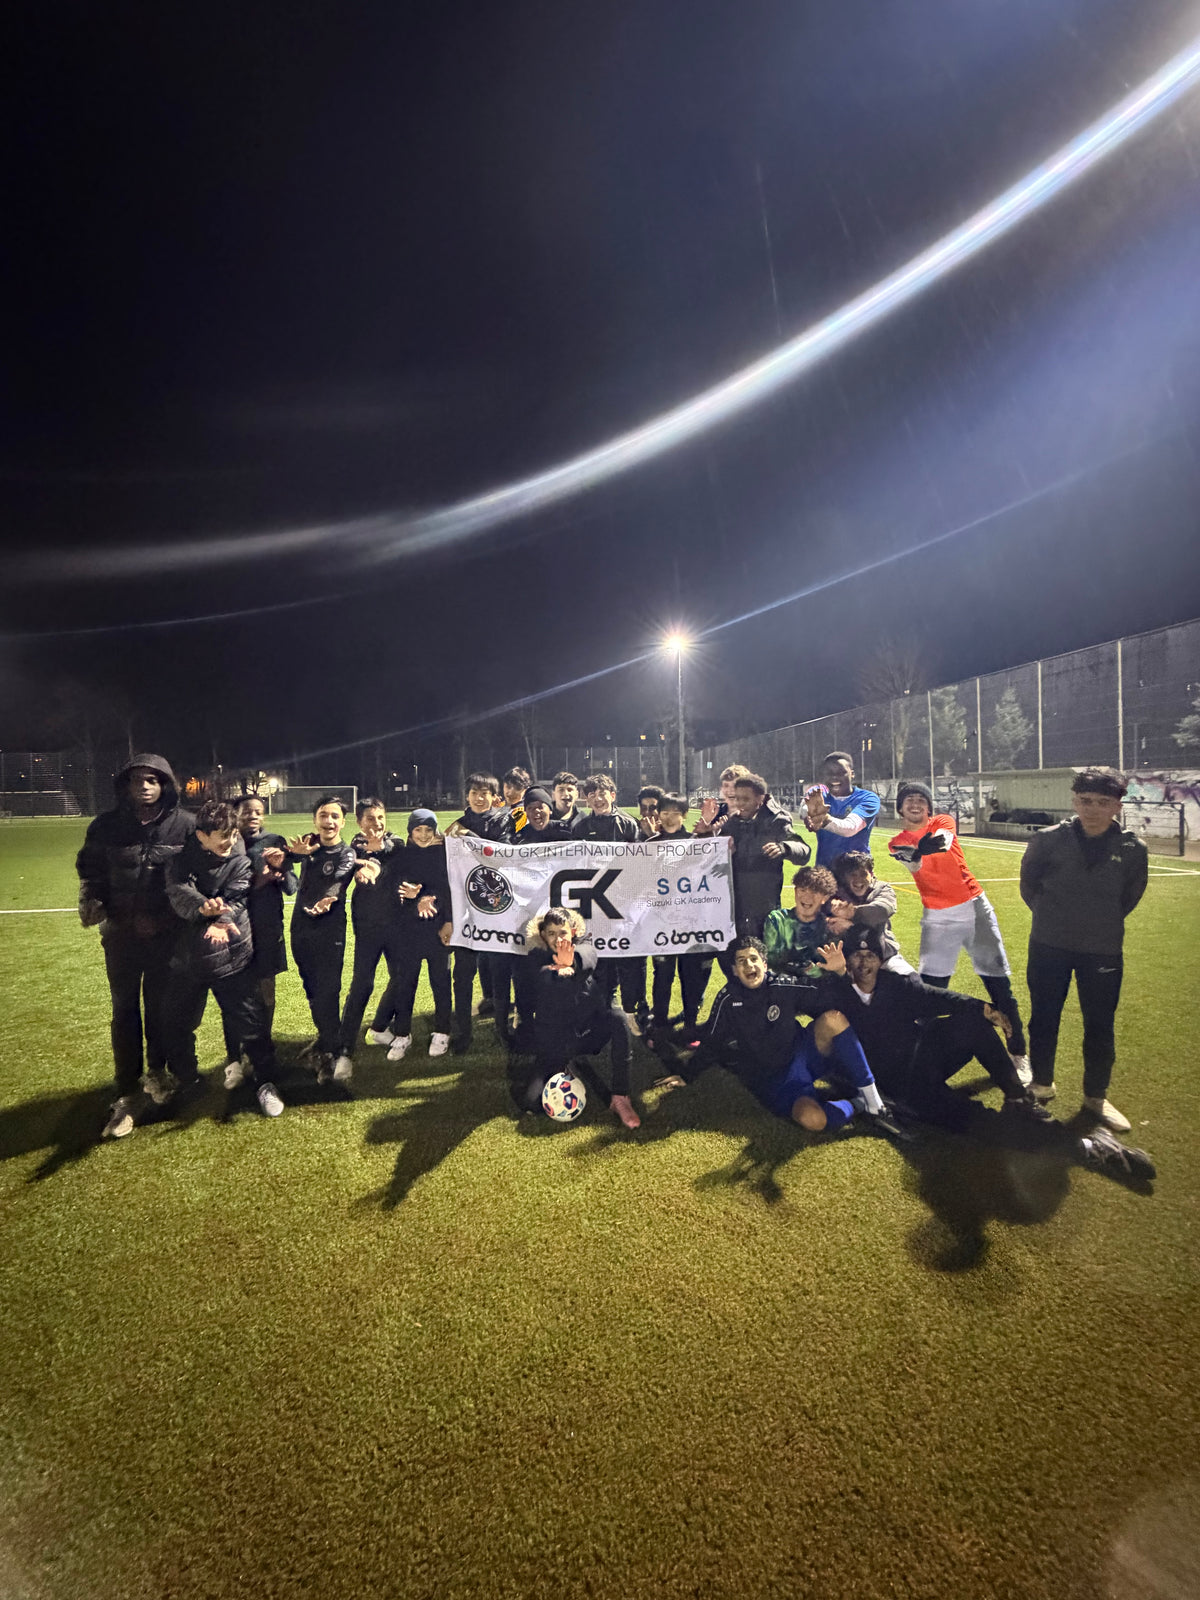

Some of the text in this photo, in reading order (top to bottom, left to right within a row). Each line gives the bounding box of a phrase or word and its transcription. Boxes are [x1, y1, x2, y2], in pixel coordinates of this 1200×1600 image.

[519, 846, 539, 857] GK
[543, 844, 652, 858] INTERNATIONAL
[656, 842, 719, 856] PROJECT
[549, 869, 625, 919] GK
[646, 899, 672, 907] Suzuki
[688, 896, 721, 904] Academy
[670, 929, 724, 945] bonera
